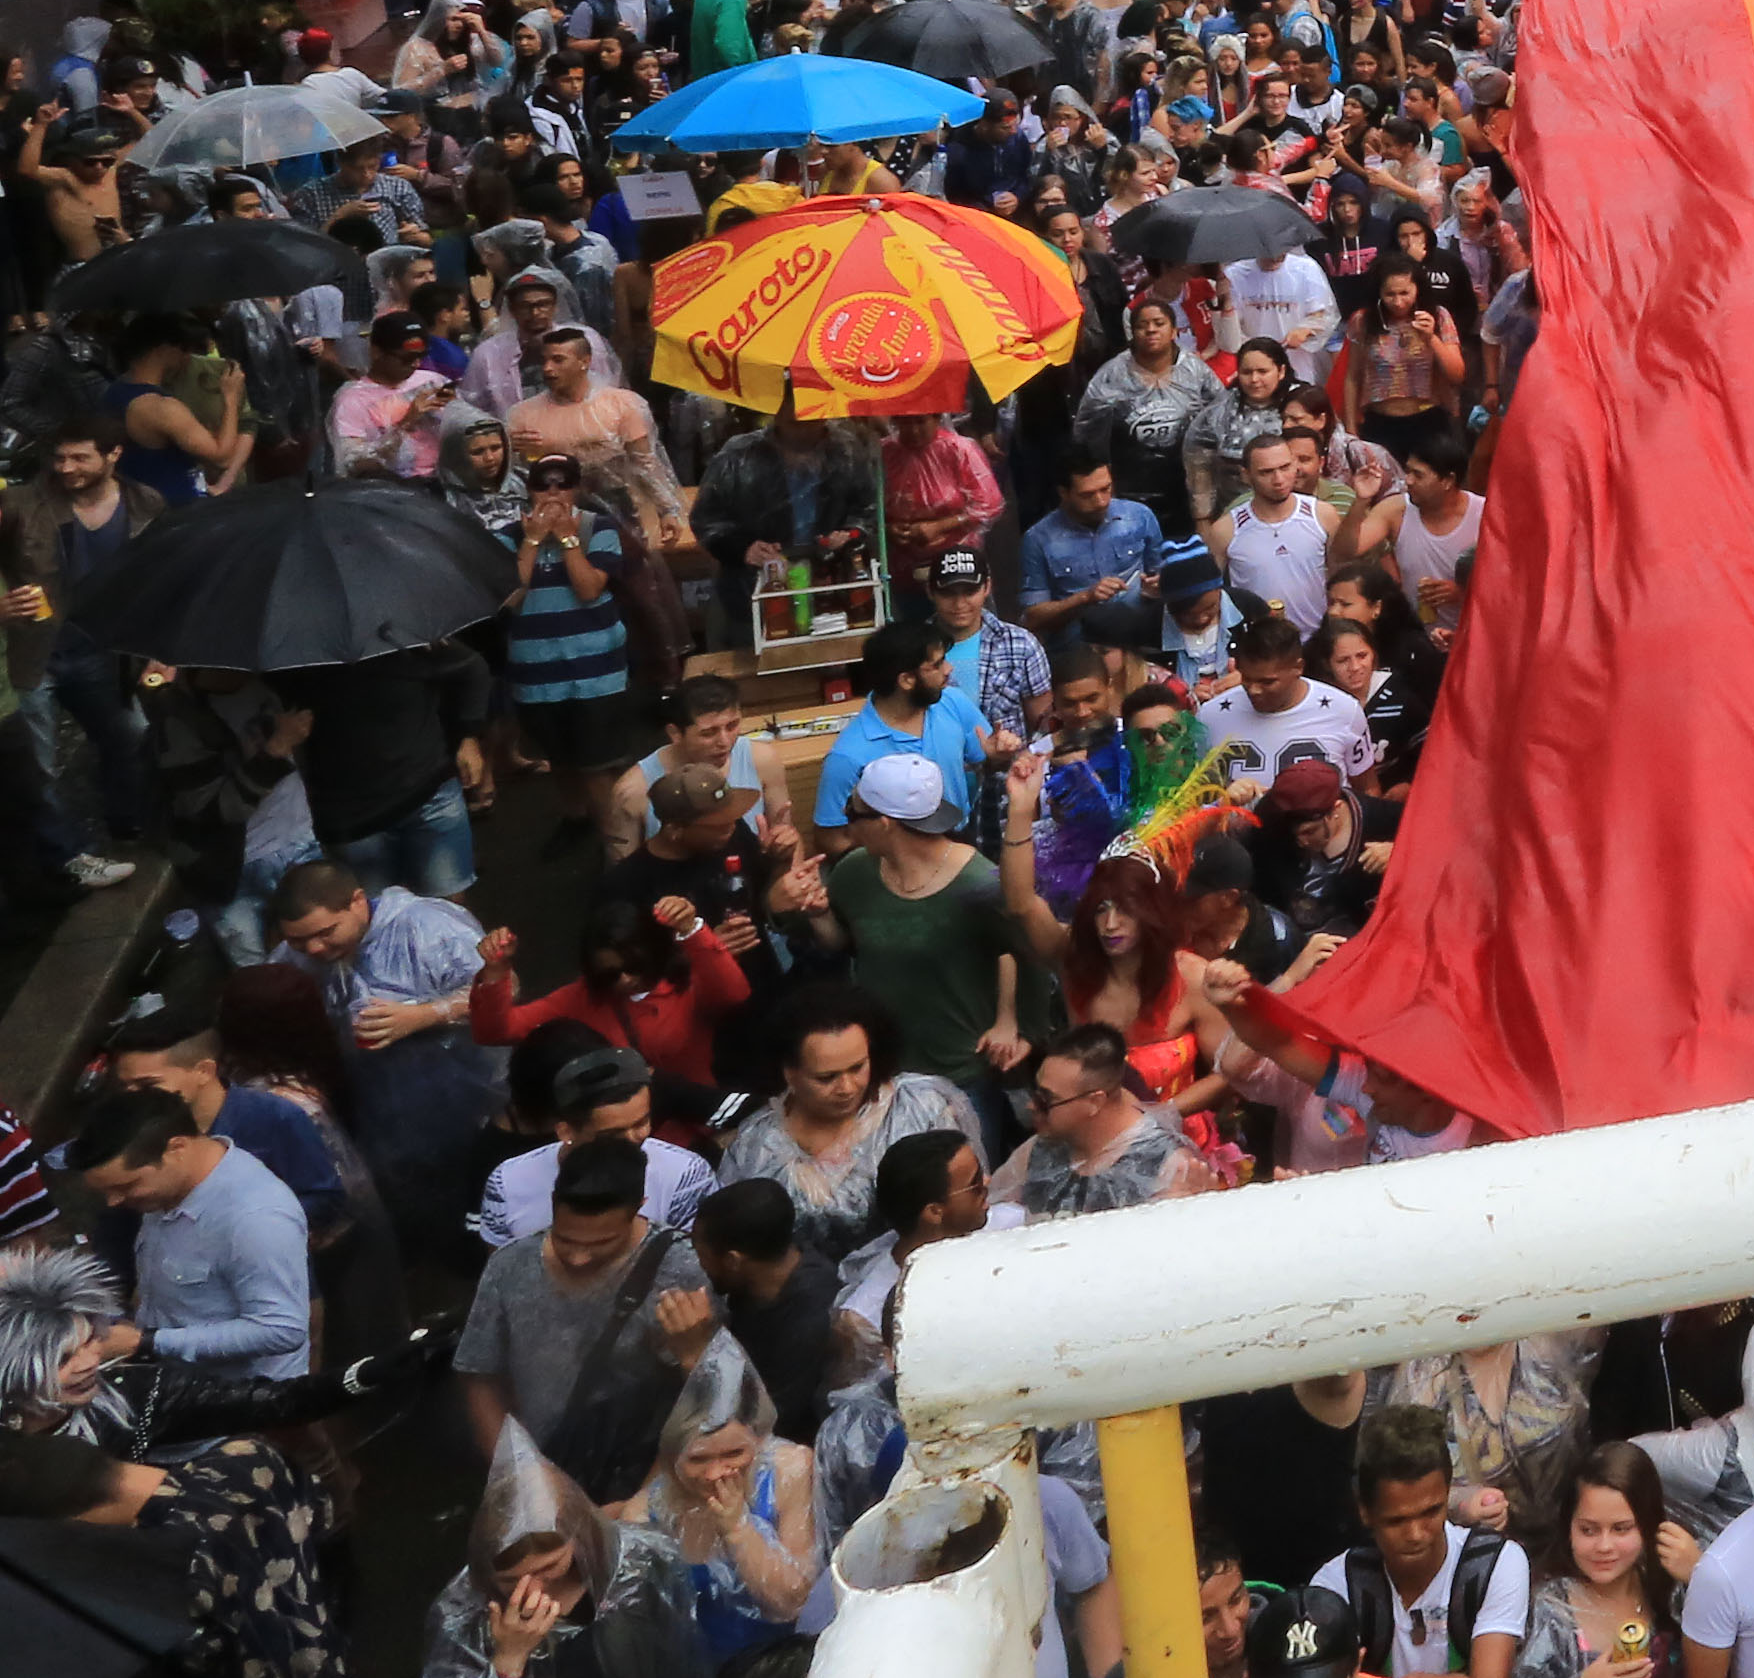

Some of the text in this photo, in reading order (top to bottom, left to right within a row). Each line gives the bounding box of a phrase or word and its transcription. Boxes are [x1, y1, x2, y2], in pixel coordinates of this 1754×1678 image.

[687, 242, 826, 397] Garoto
[831, 302, 887, 377] Serenata
[880, 312, 914, 373] Amor
